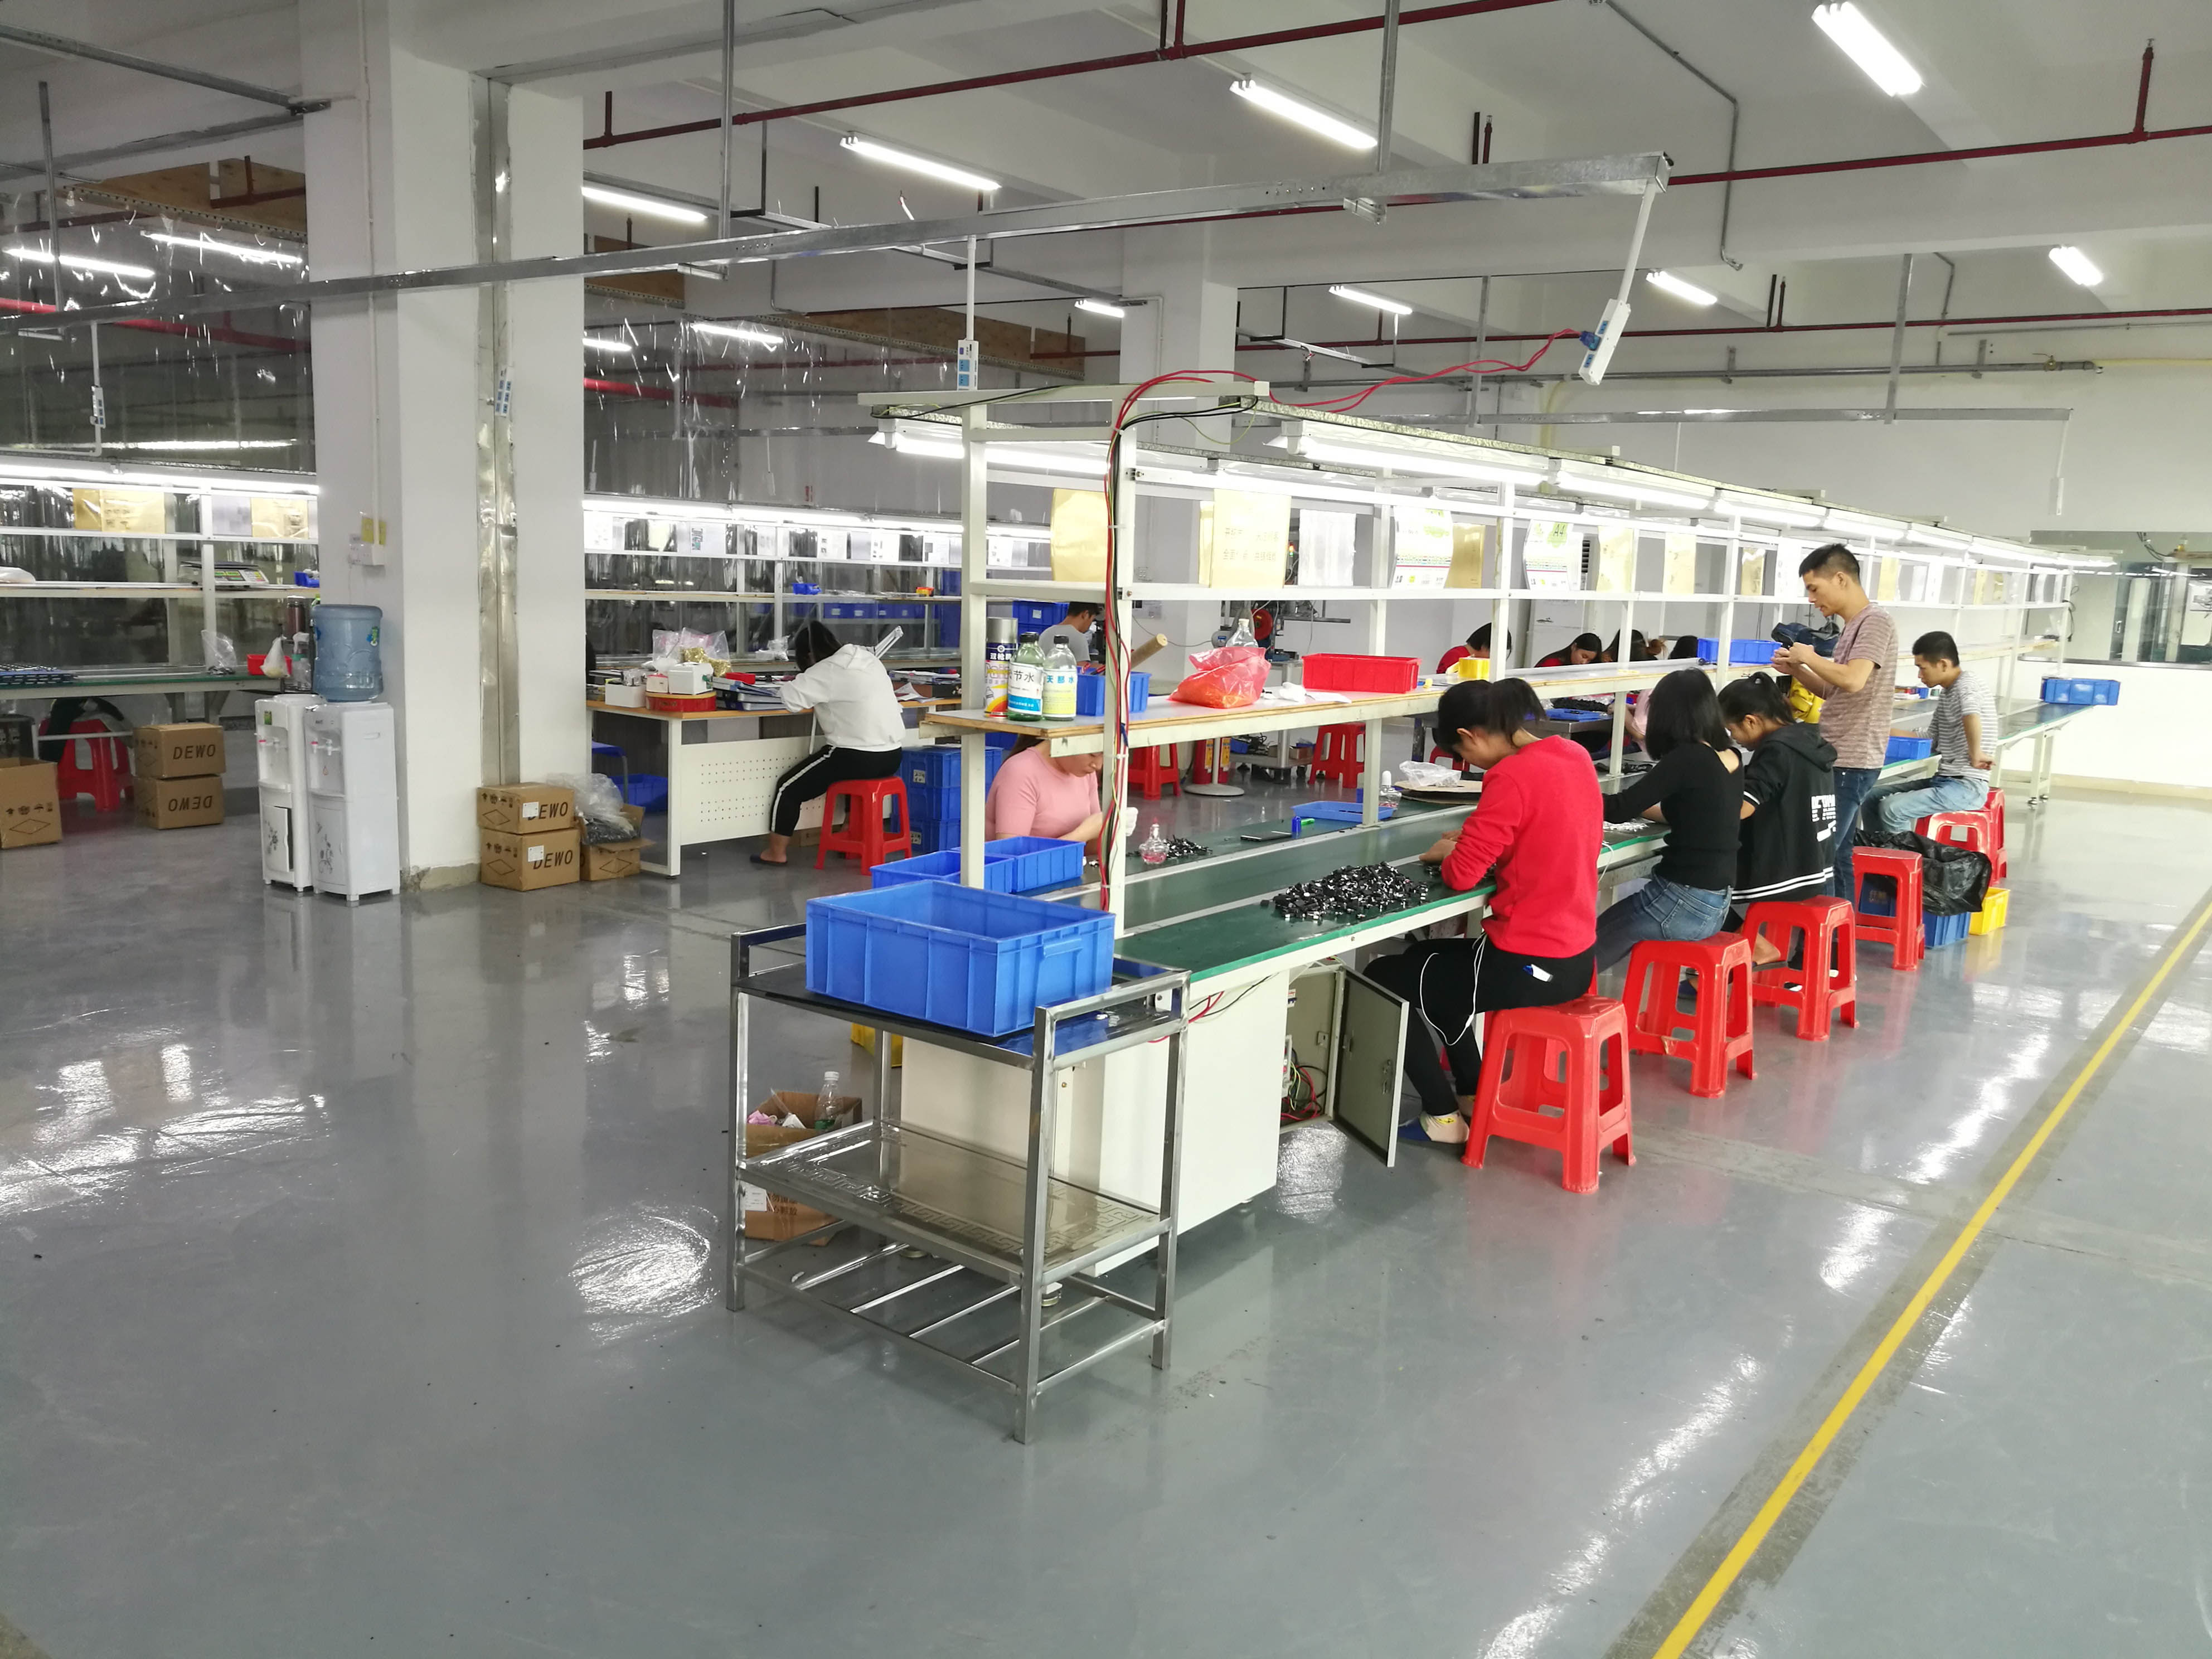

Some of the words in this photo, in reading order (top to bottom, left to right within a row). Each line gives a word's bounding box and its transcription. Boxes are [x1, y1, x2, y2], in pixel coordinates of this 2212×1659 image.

[1553, 523, 1565, 536] A4
[1010, 670, 1034, 682] 节水
[173, 744, 216, 759] DEWO
[168, 795, 213, 812] DEWO
[528, 802, 568, 820] EWO
